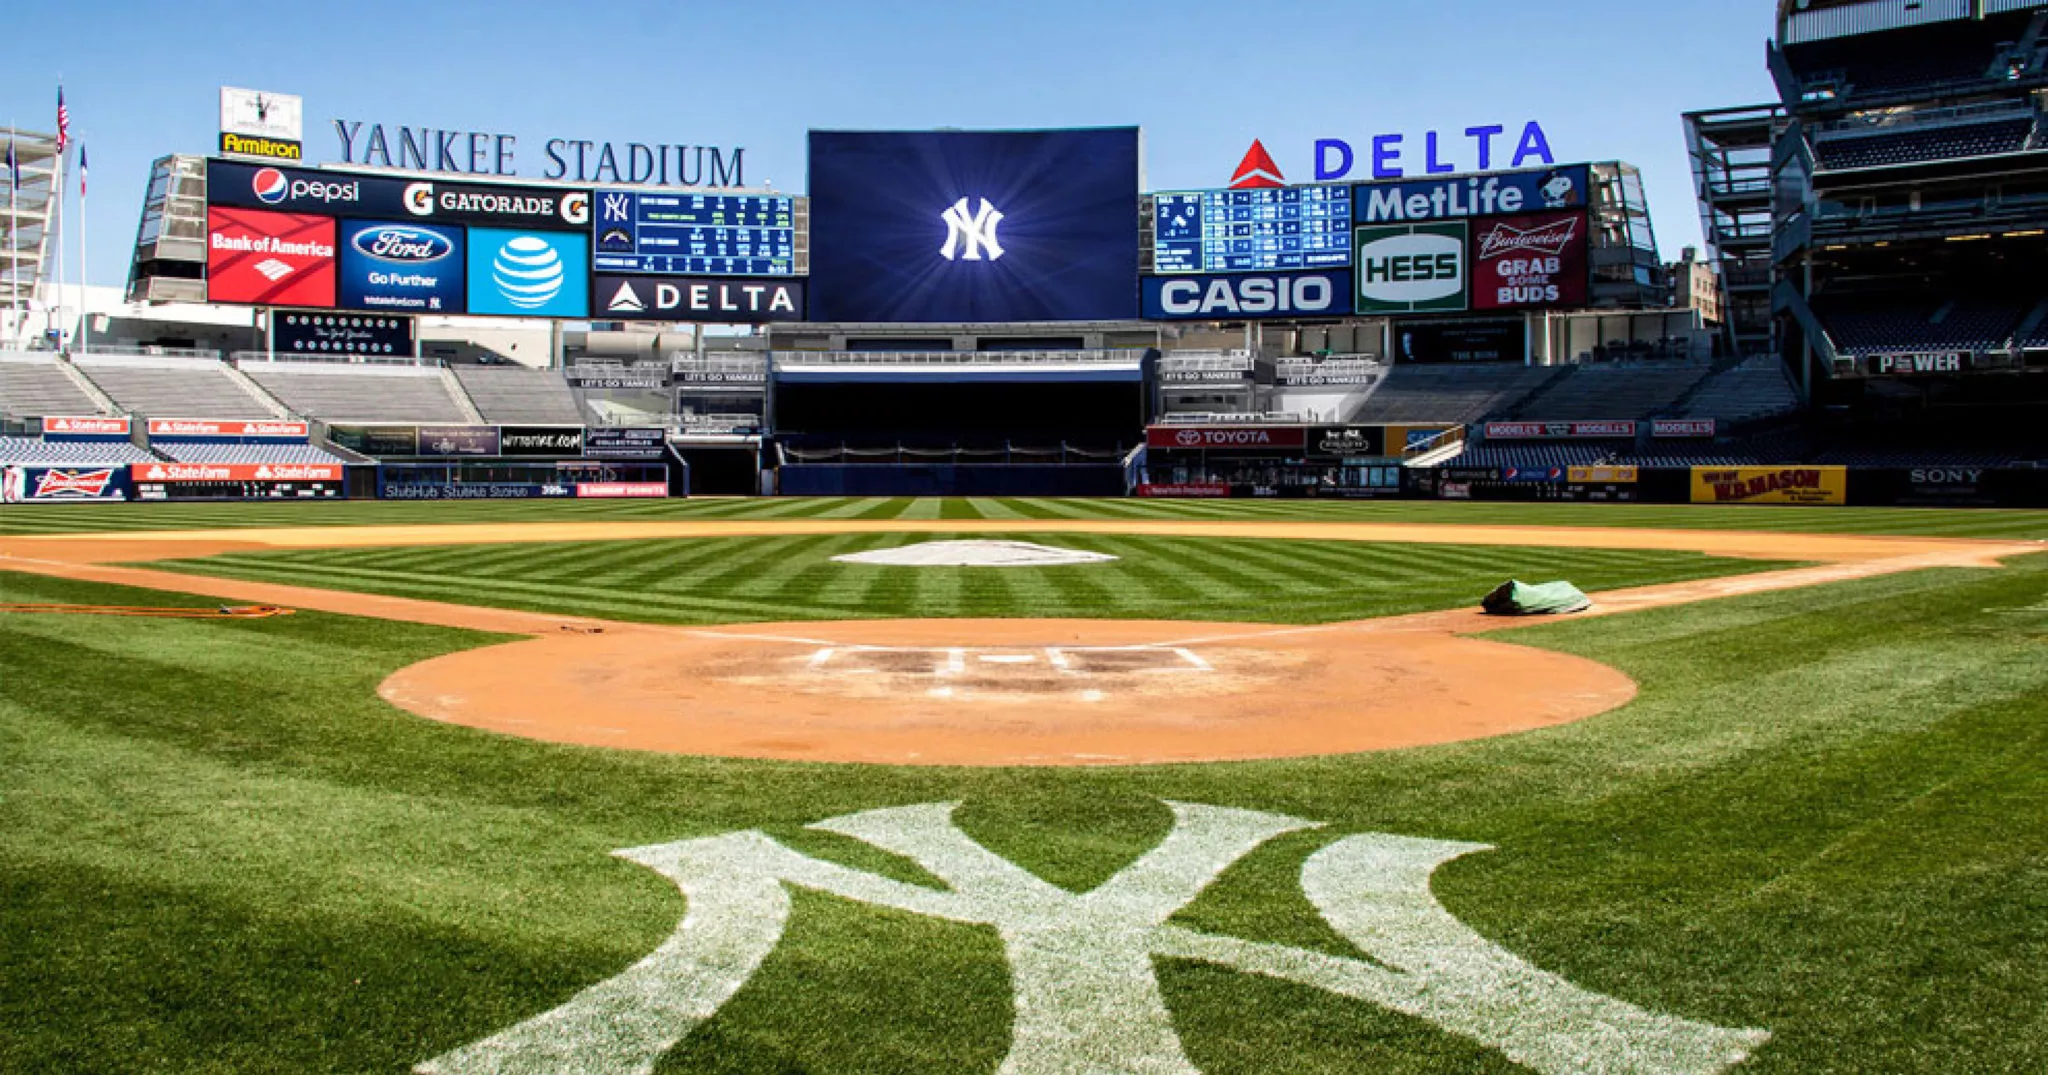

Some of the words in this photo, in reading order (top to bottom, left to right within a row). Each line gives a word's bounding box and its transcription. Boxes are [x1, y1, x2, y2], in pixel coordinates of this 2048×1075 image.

[224, 133, 300, 158] Armitron
[333, 120, 516, 176] YANKEE
[544, 139, 745, 188] STADIUM
[1313, 121, 1555, 180] DELTA
[291, 179, 359, 203] pepsi
[1367, 177, 1523, 222] MetLife
[403, 183, 433, 216] G
[440, 192, 553, 216] GATORADE
[560, 192, 589, 224] G
[212, 233, 253, 251] Bank
[254, 237, 270, 252] of
[271, 237, 334, 256] America
[372, 231, 433, 257] Ford
[1478, 230, 1575, 250] Budweiser
[1366, 253, 1458, 283] HESS
[1497, 257, 1561, 276] GRAB
[368, 272, 387, 284] Go
[391, 273, 437, 287] Further
[1508, 275, 1549, 285] SOME
[656, 283, 796, 312] DELTA
[1161, 275, 1332, 314] CASIO
[1497, 285, 1560, 304] BUDS
[1204, 431, 1269, 443] TOYOTA
[1910, 468, 1984, 483] SONY
[385, 485, 438, 498] StubHub
